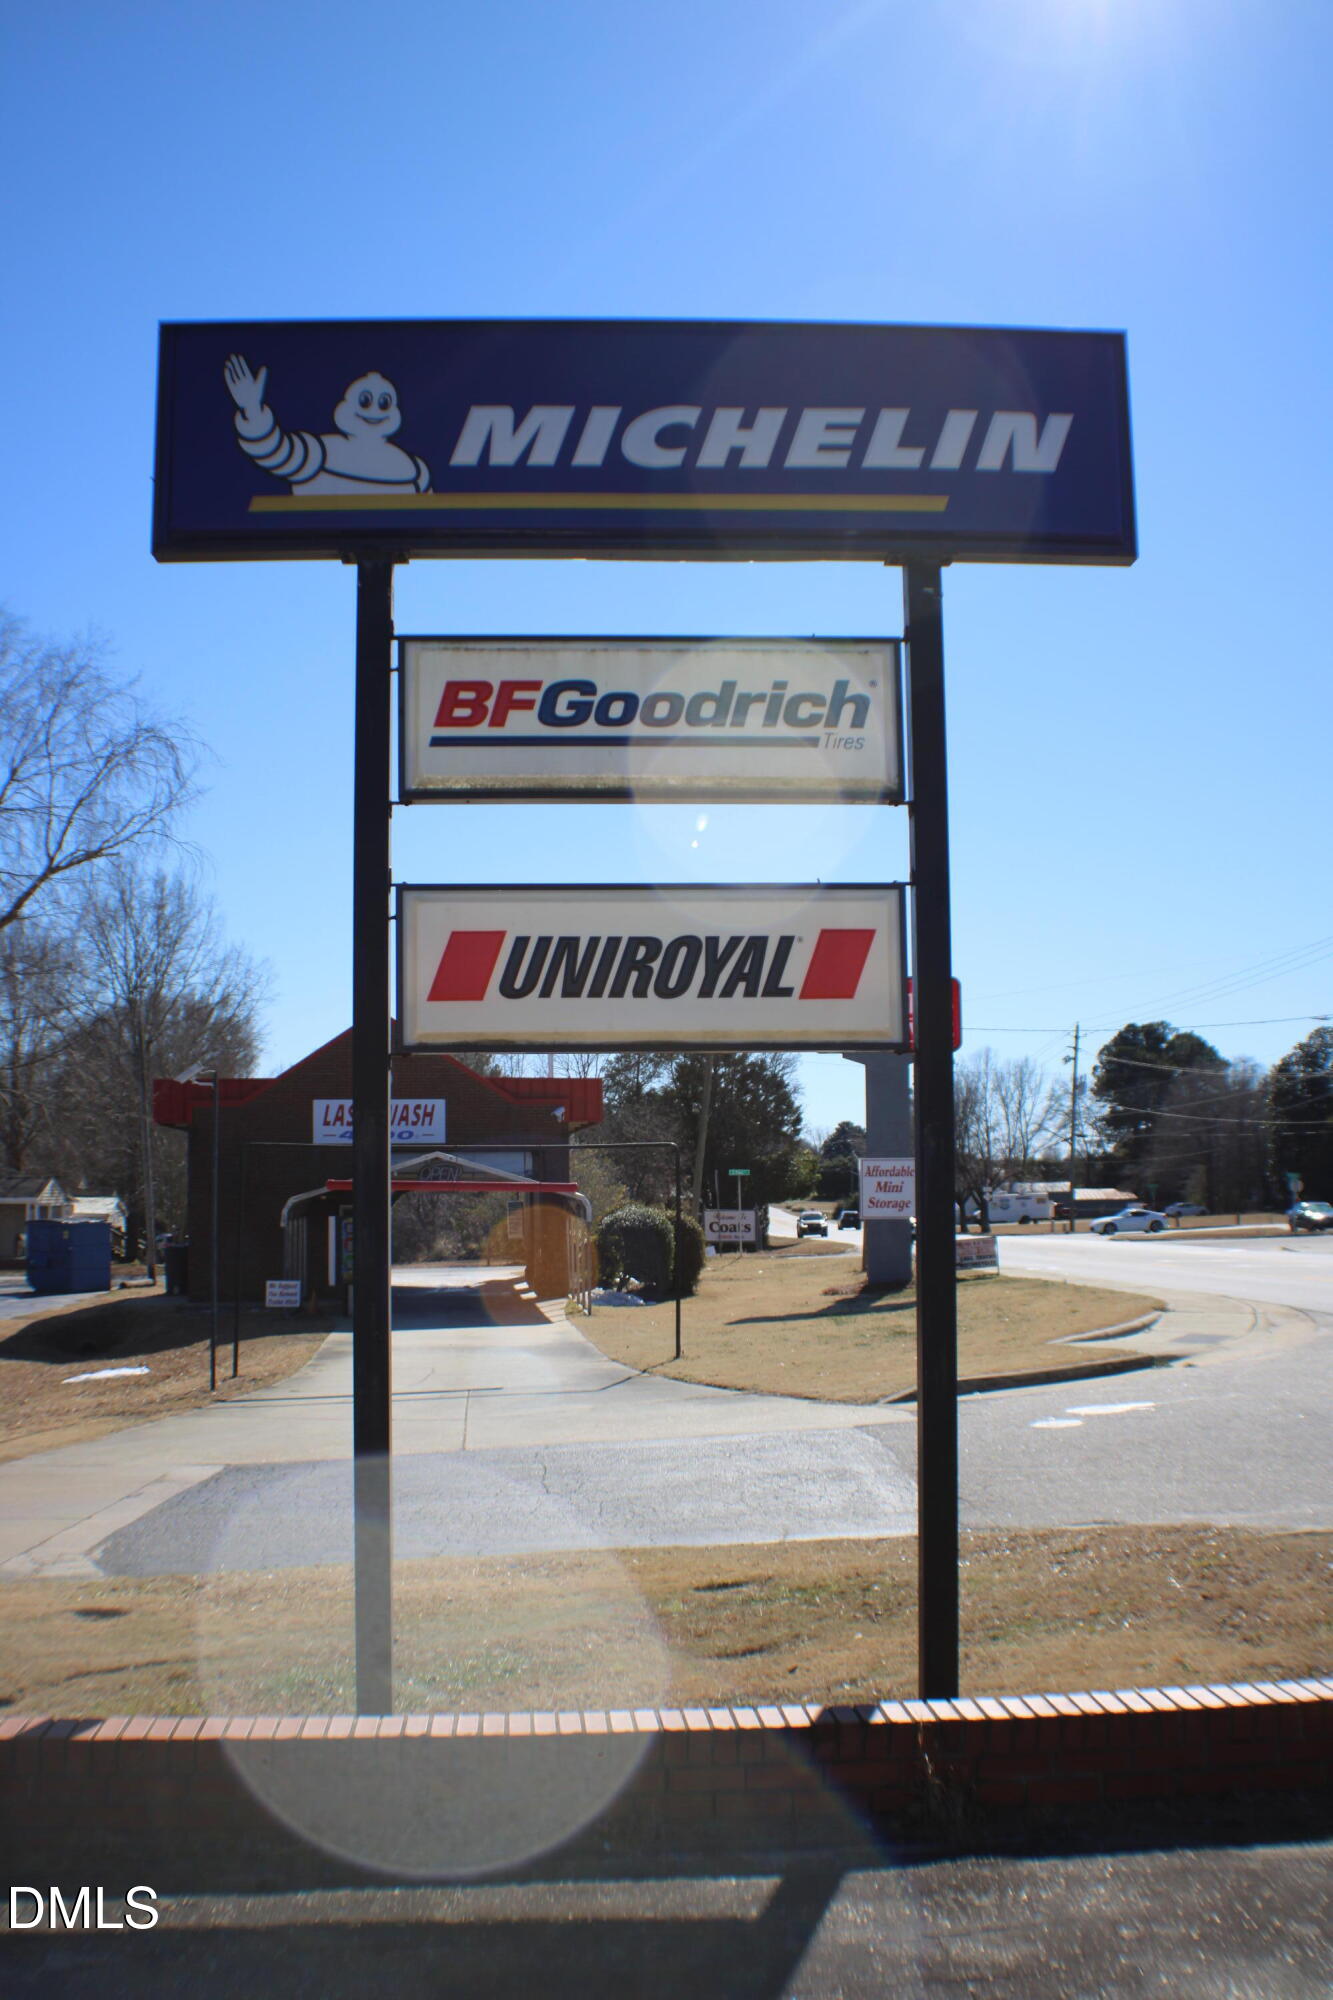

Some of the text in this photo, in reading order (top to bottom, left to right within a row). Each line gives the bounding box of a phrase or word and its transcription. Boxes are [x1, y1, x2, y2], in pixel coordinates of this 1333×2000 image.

[449, 405, 1074, 473] MICHELIN
[433, 680, 871, 729] BFGoodrich
[823, 732, 865, 750] Tires
[499, 934, 797, 1000] UNIROYAL
[322, 1103, 353, 1127] LAS
[865, 1165, 915, 1176] Affordable
[874, 1181, 904, 1192] Mini
[868, 1197, 911, 1212] Storage
